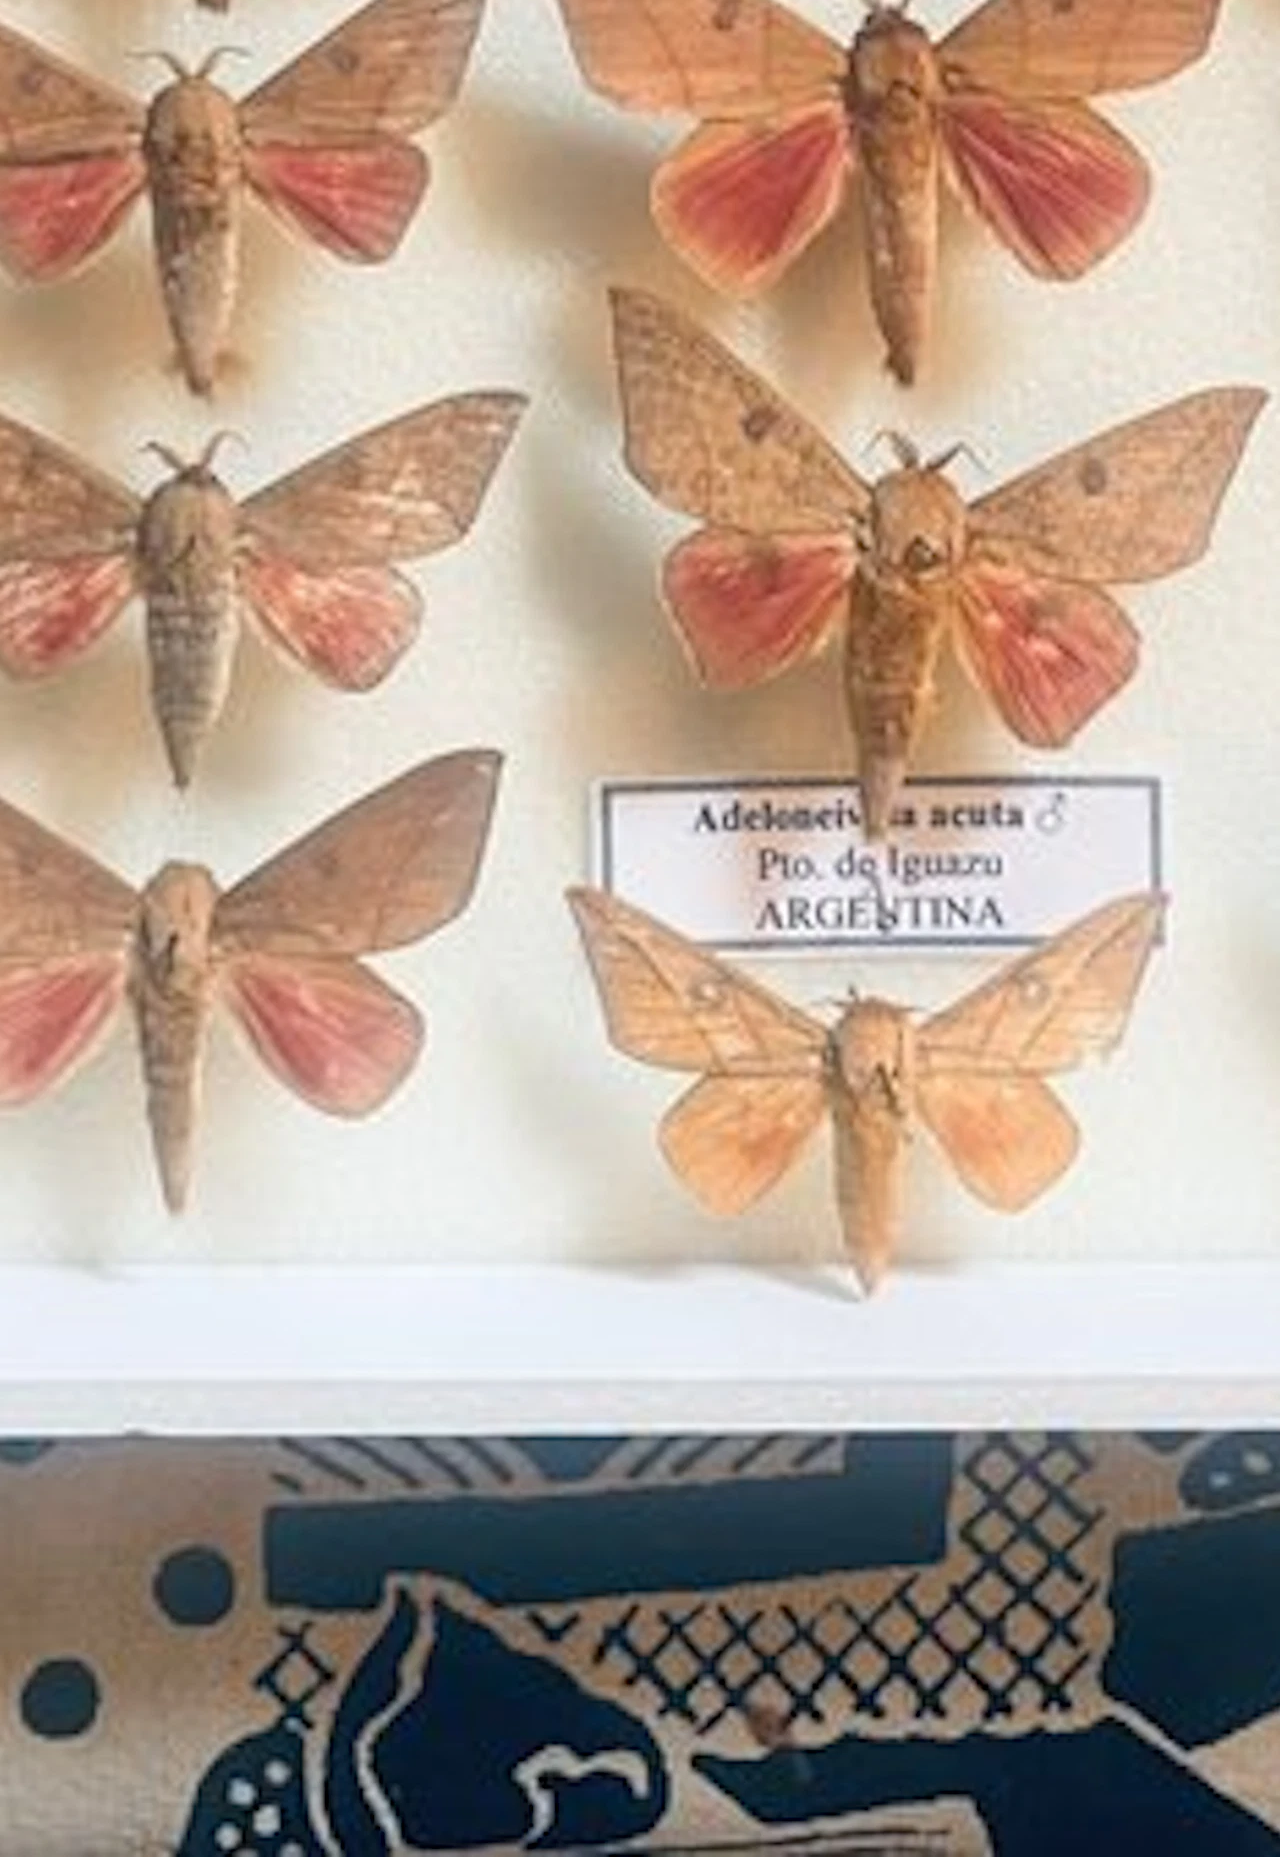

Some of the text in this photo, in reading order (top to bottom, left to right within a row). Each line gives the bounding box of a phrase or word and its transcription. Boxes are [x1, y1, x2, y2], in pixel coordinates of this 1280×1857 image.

[930, 801, 1022, 830] acuta
[758, 849, 821, 879] Pto.
[887, 849, 1003, 883] Iguazu
[755, 896, 1004, 932] ARGENTINA
